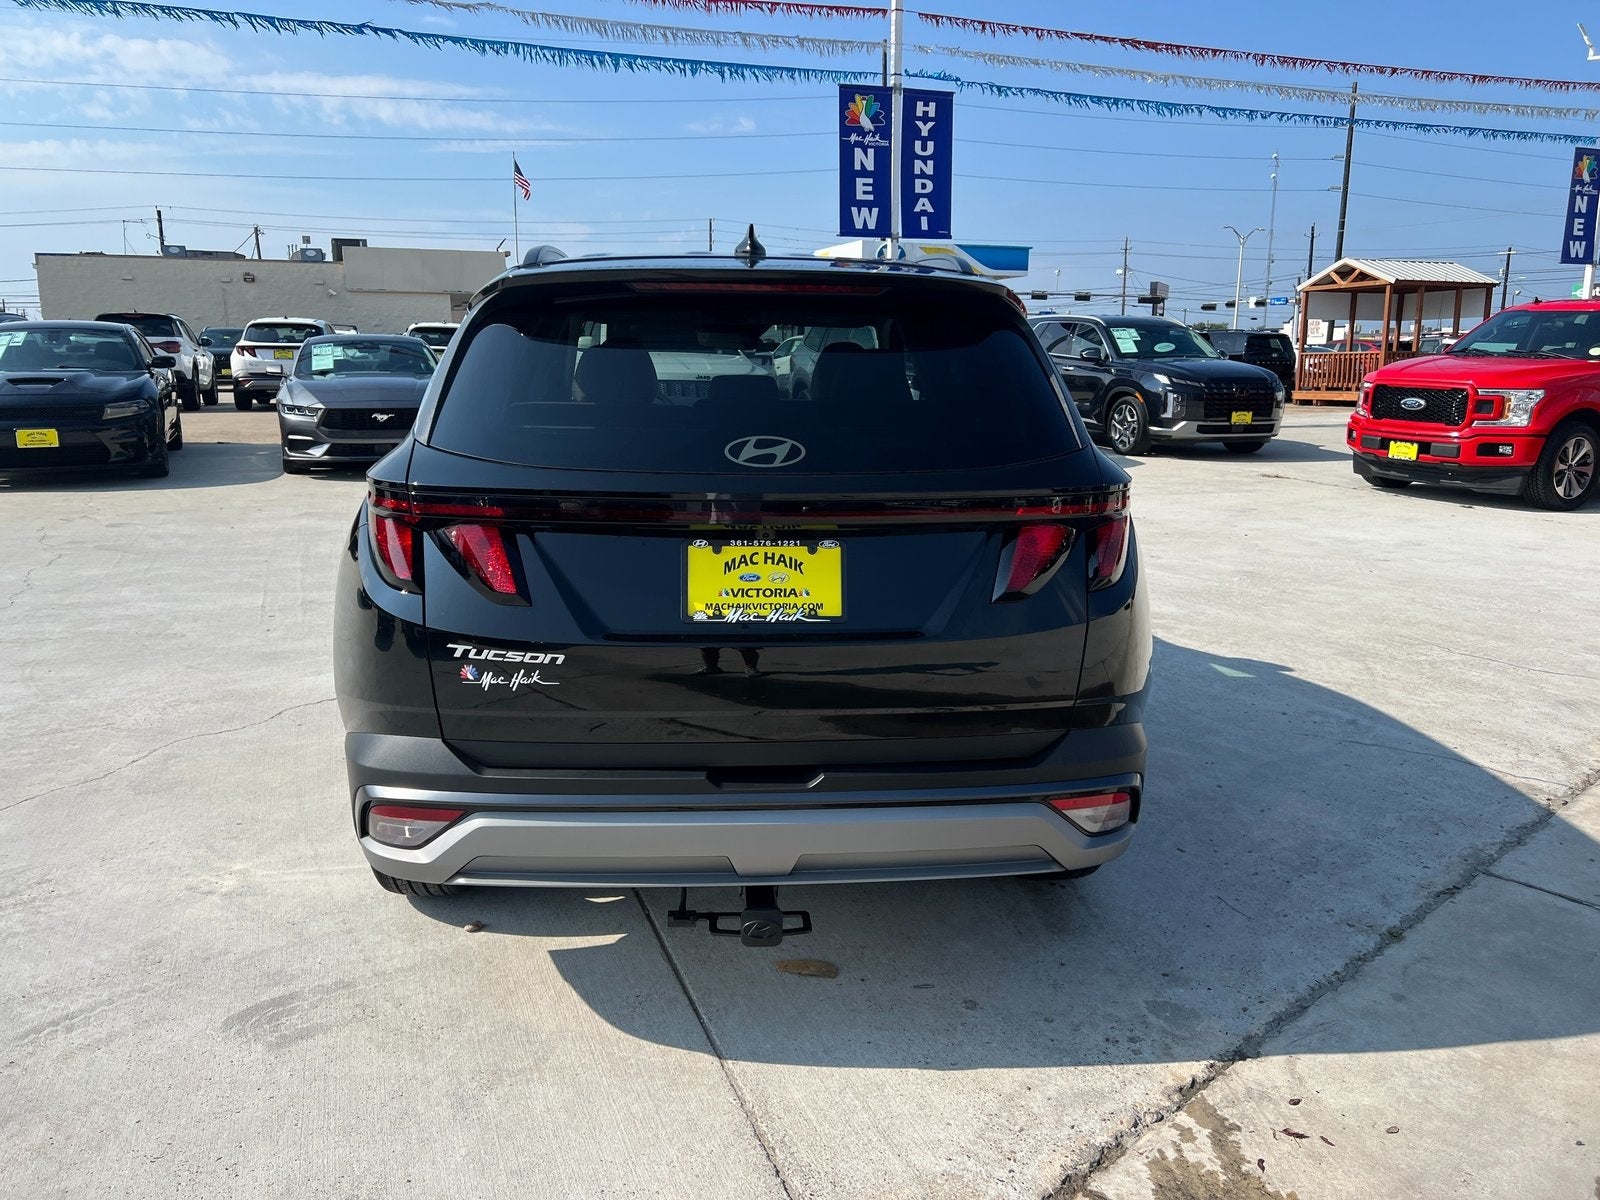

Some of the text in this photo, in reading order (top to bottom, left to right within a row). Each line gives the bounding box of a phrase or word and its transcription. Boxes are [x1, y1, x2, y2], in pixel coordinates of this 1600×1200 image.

[846, 132, 885, 145] Mac Haik
[913, 101, 936, 231] HYUNDAI
[850, 147, 879, 230] NEW
[1569, 195, 1588, 259] NEW
[729, 539, 801, 547] 361-576-1221
[723, 551, 805, 575] MAC HAIK
[741, 574, 759, 582] Ford
[730, 587, 799, 598] VICTORIA
[704, 602, 824, 611] MACHAIKVICTORIACOM
[718, 607, 814, 623] Mac Haik
[474, 668, 549, 692] Mac Haik
